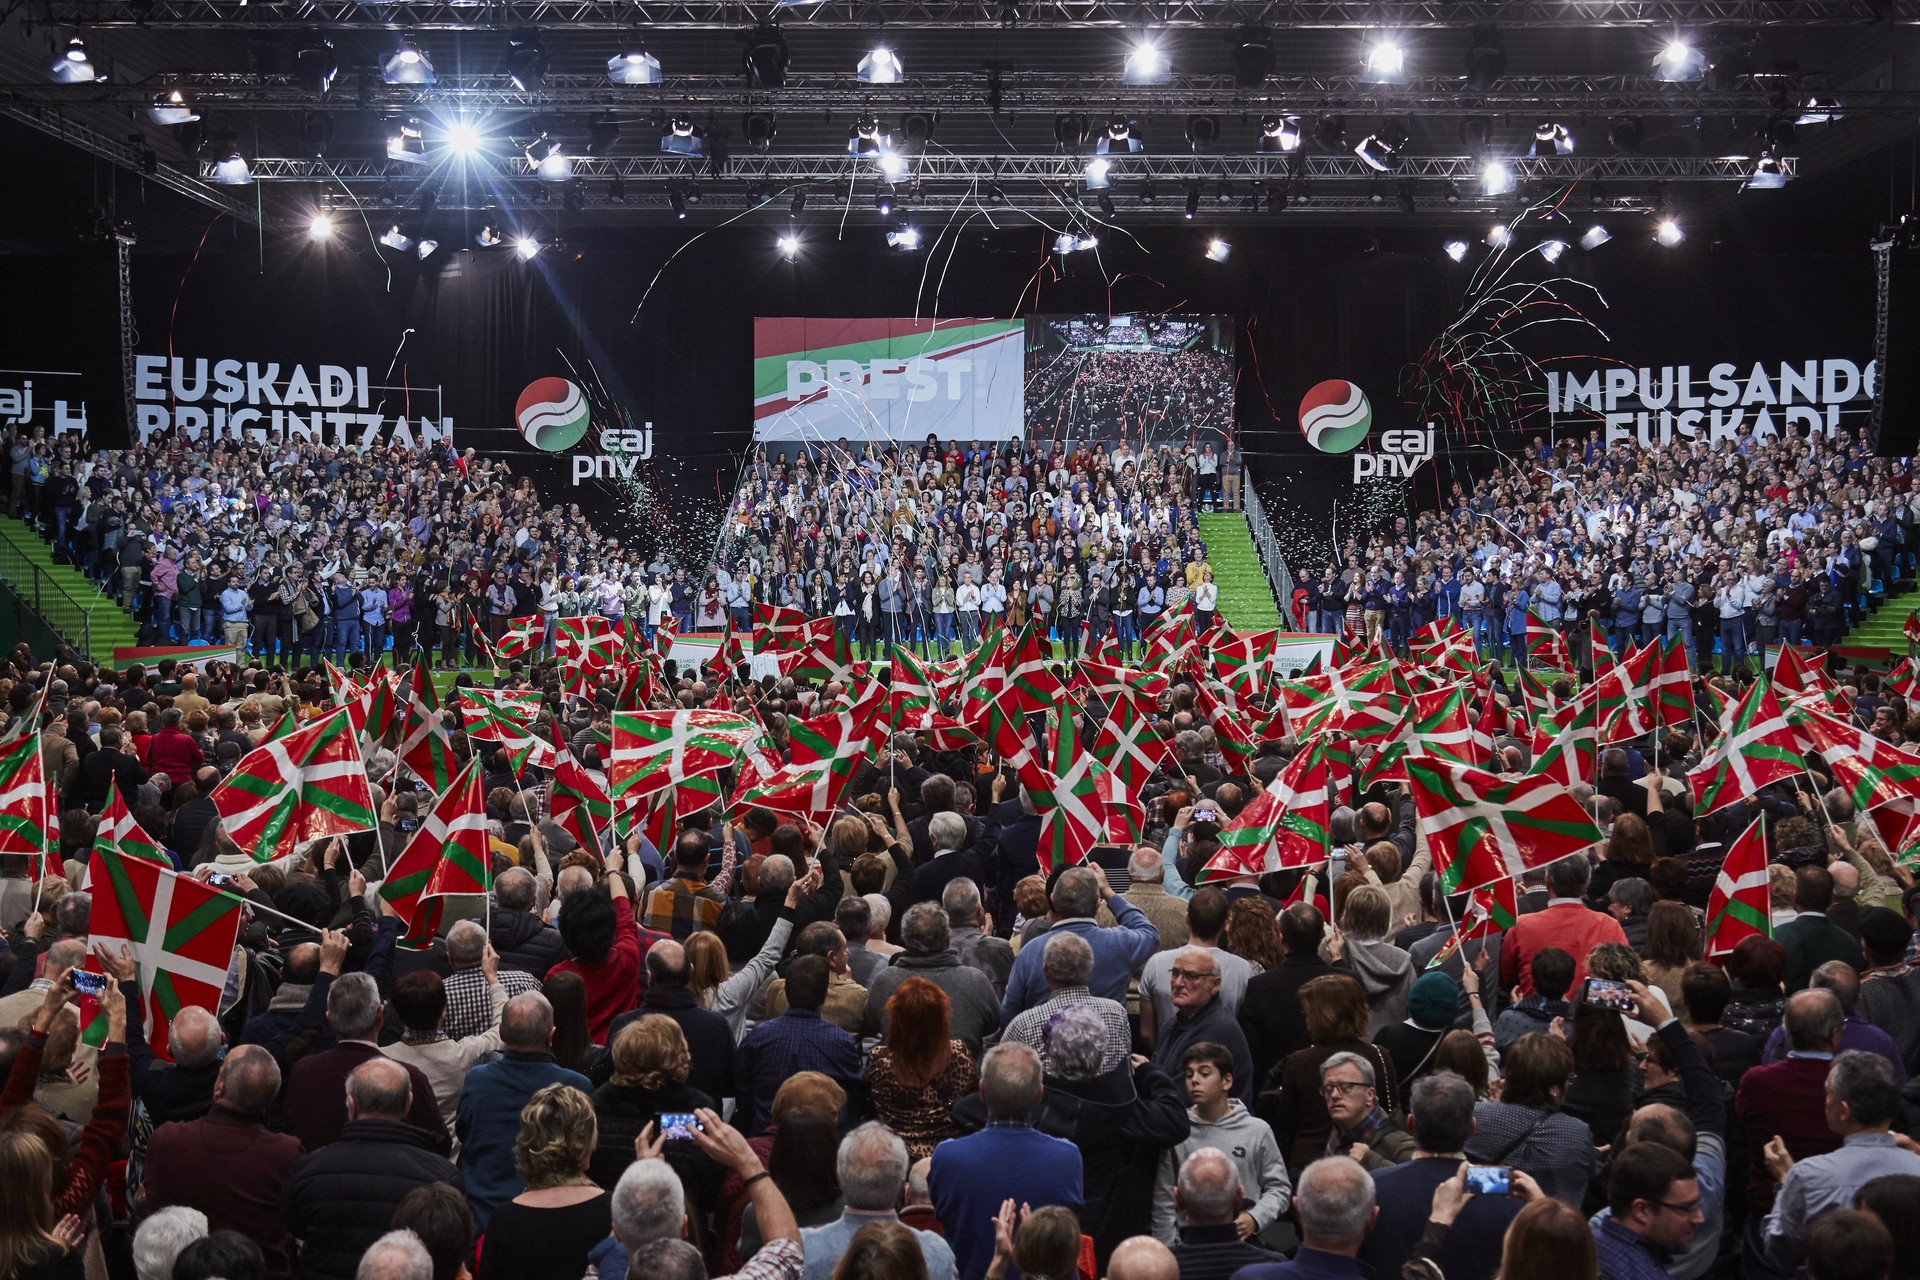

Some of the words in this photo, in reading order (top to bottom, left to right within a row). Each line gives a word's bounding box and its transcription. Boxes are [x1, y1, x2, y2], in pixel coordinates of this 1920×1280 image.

[136, 354, 369, 408] EUSKADI
[0, 380, 33, 424] aj
[599, 421, 653, 460] eaj
[1381, 421, 1435, 460] eaj
[1605, 405, 1840, 450] EUSKADI
[572, 455, 640, 486] pnv
[1353, 453, 1421, 485] pnv
